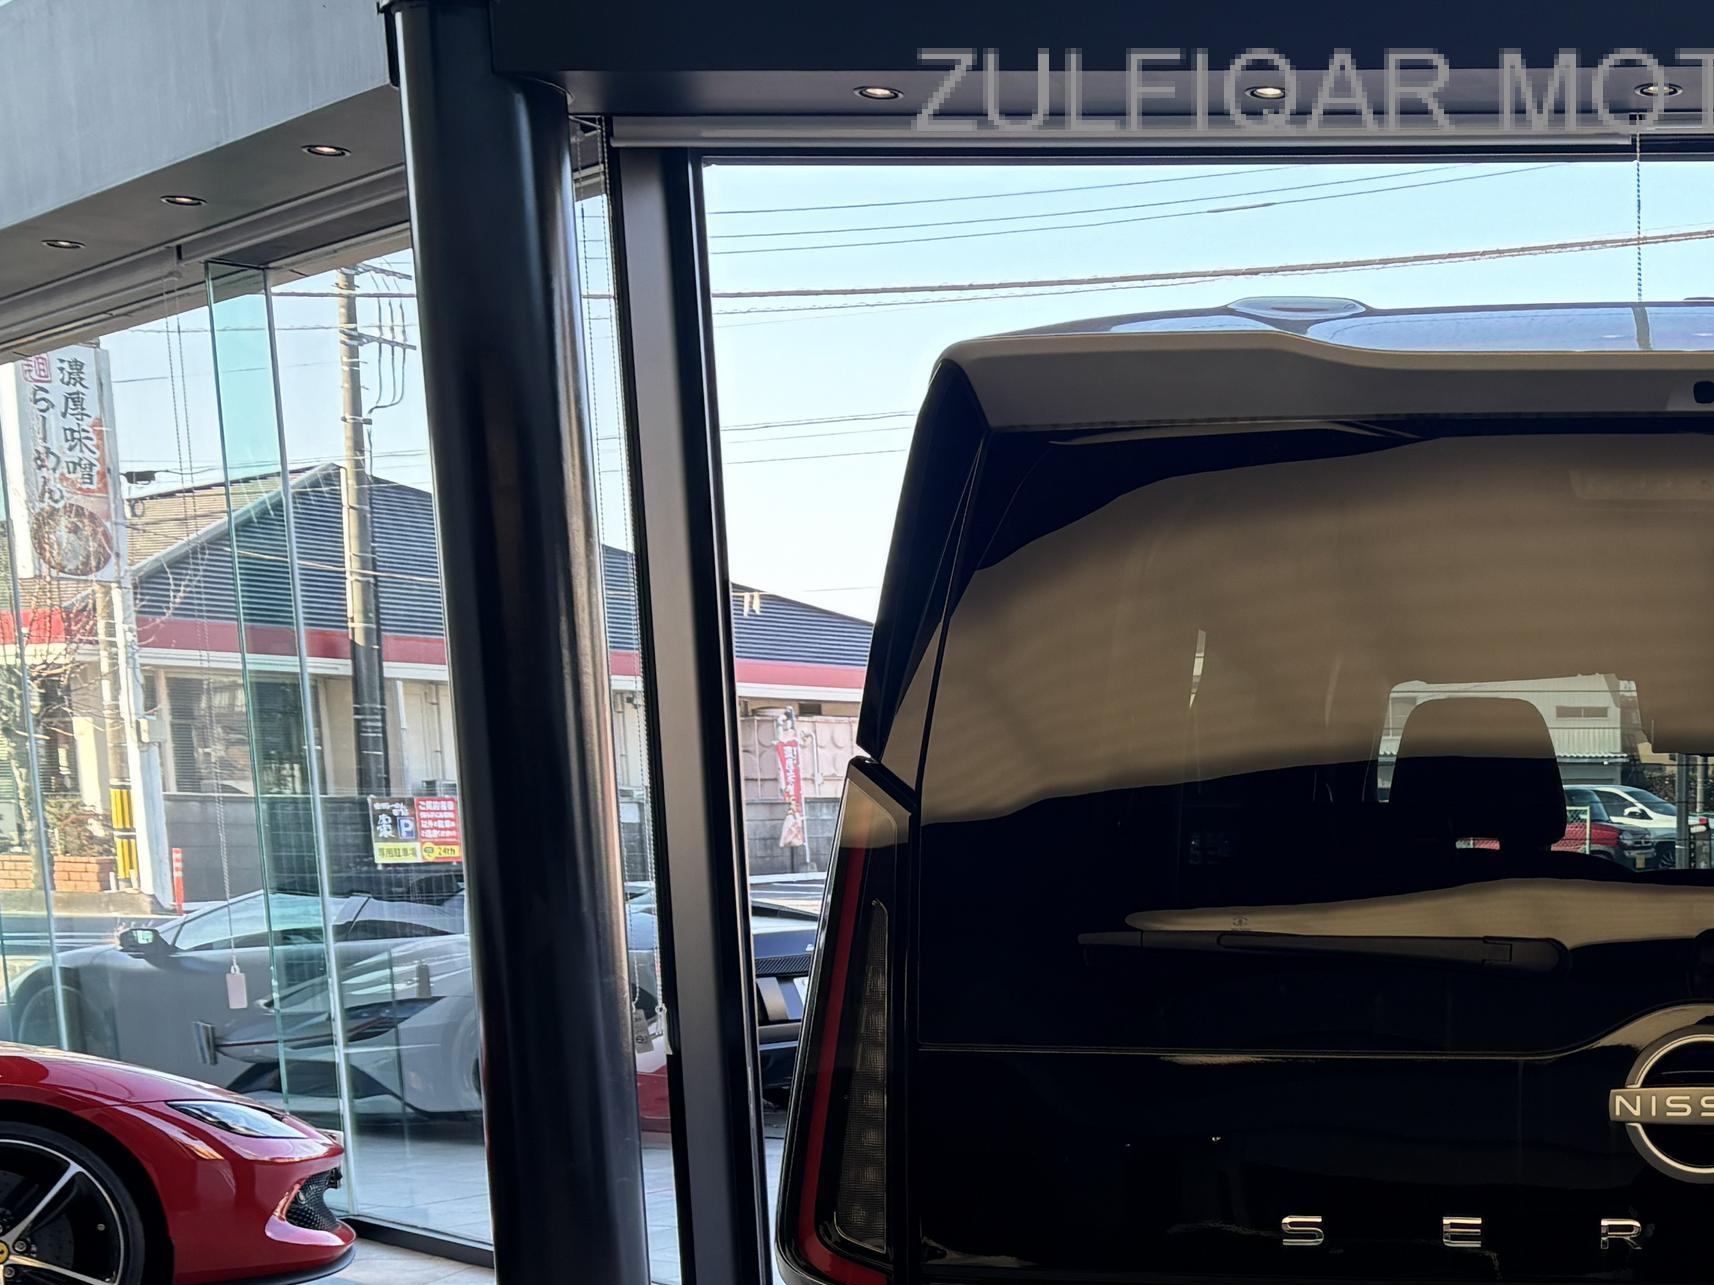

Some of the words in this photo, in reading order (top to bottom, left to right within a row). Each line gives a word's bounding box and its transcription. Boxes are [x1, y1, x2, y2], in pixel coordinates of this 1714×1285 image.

[31, 384, 64, 505] らーめん
[57, 357, 97, 486] 濃厚味噌
